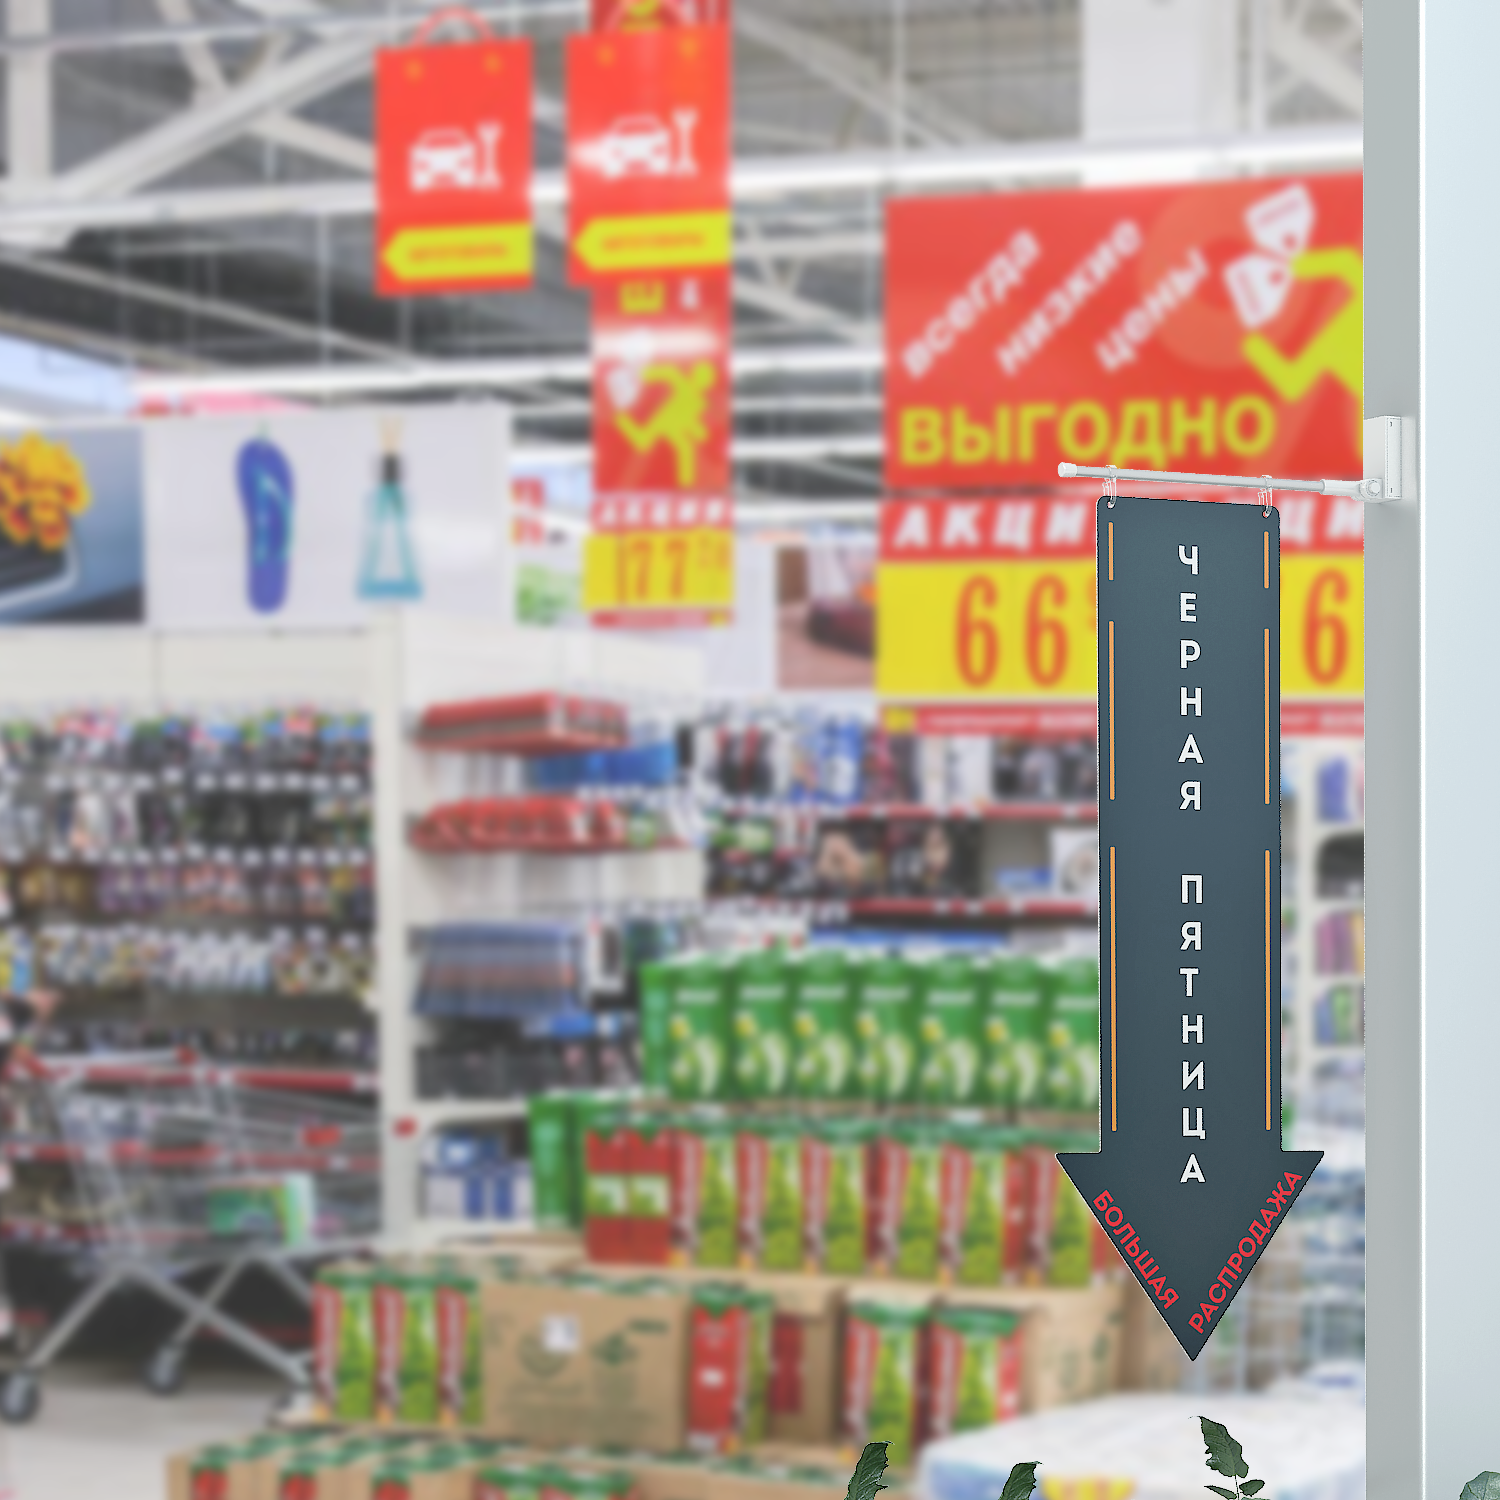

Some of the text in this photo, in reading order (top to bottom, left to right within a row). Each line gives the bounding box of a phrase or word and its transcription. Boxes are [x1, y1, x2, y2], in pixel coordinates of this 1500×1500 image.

[900, 392, 1276, 470] ВЫГОДНО
[893, 503, 1087, 555] АКЦИ
[1177, 544, 1206, 1184] ЧЕРНАЯ ПЯТНИЦА
[1093, 1190, 1180, 1309] БОЛЬШАЯ
[1188, 1171, 1303, 1334] РАСПРОДАЖА
